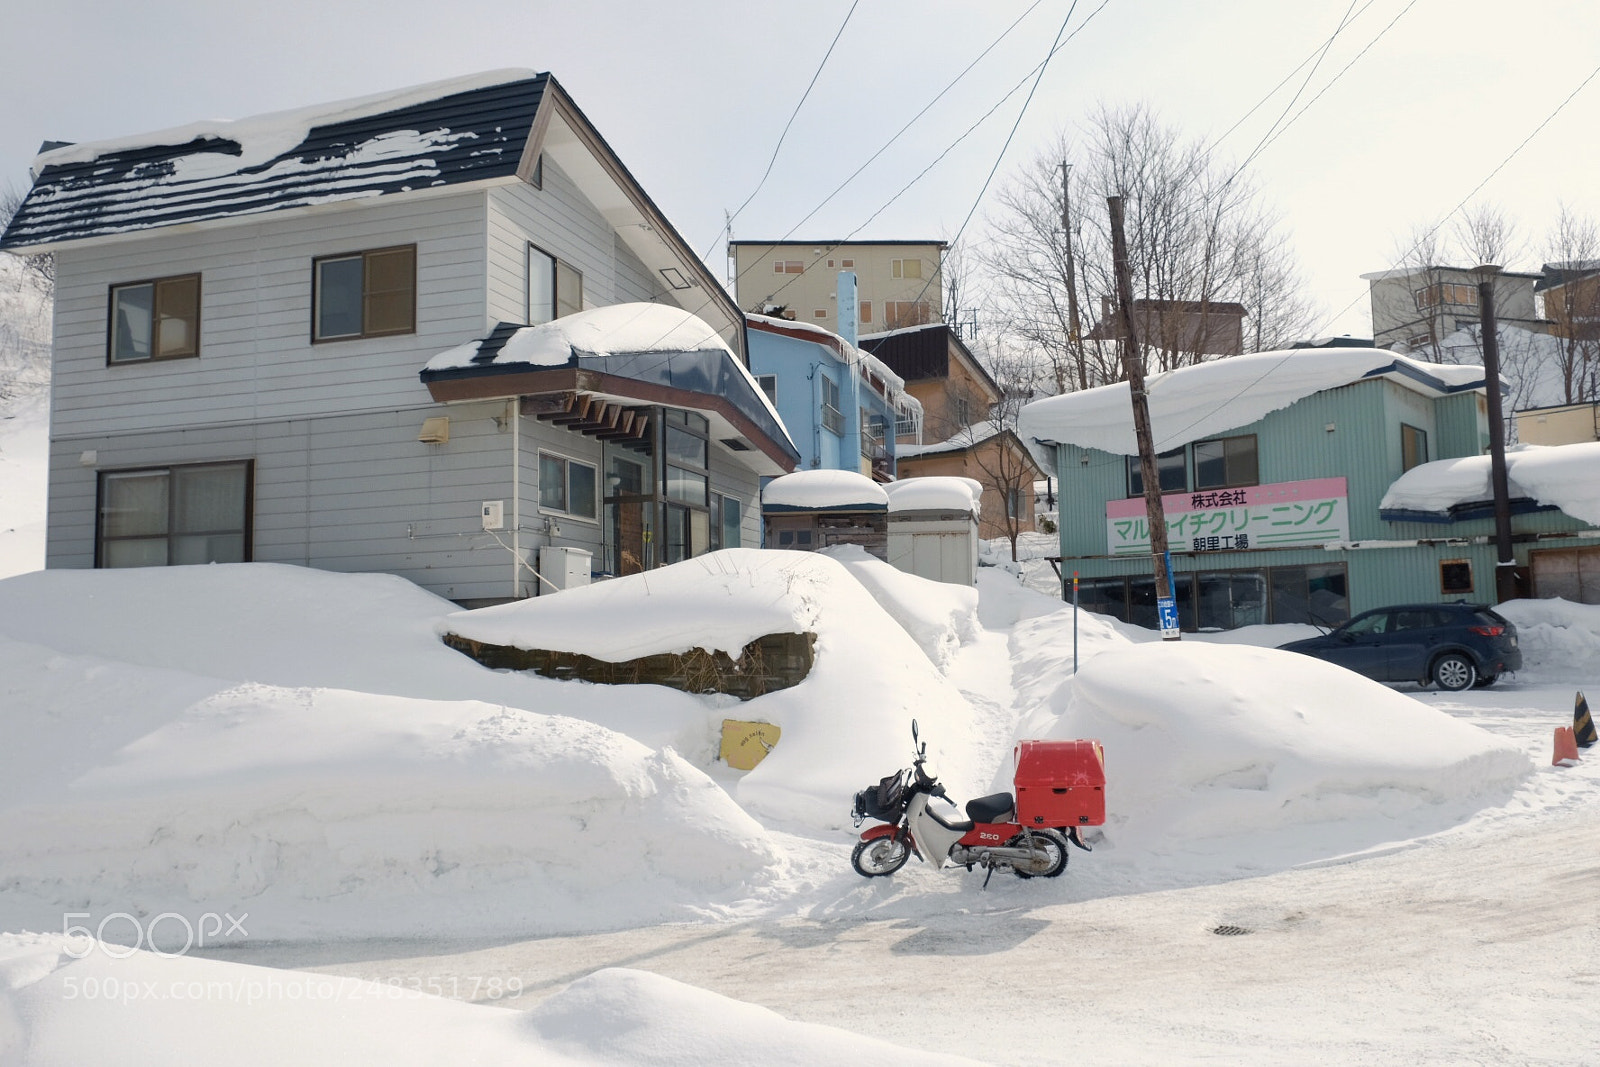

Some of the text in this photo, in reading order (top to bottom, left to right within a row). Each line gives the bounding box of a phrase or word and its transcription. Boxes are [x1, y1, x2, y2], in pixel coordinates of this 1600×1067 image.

[1191, 489, 1247, 510] 株式会社
[1113, 499, 1338, 541] マルイチクリーニング
[1193, 533, 1249, 552] 朝里工場
